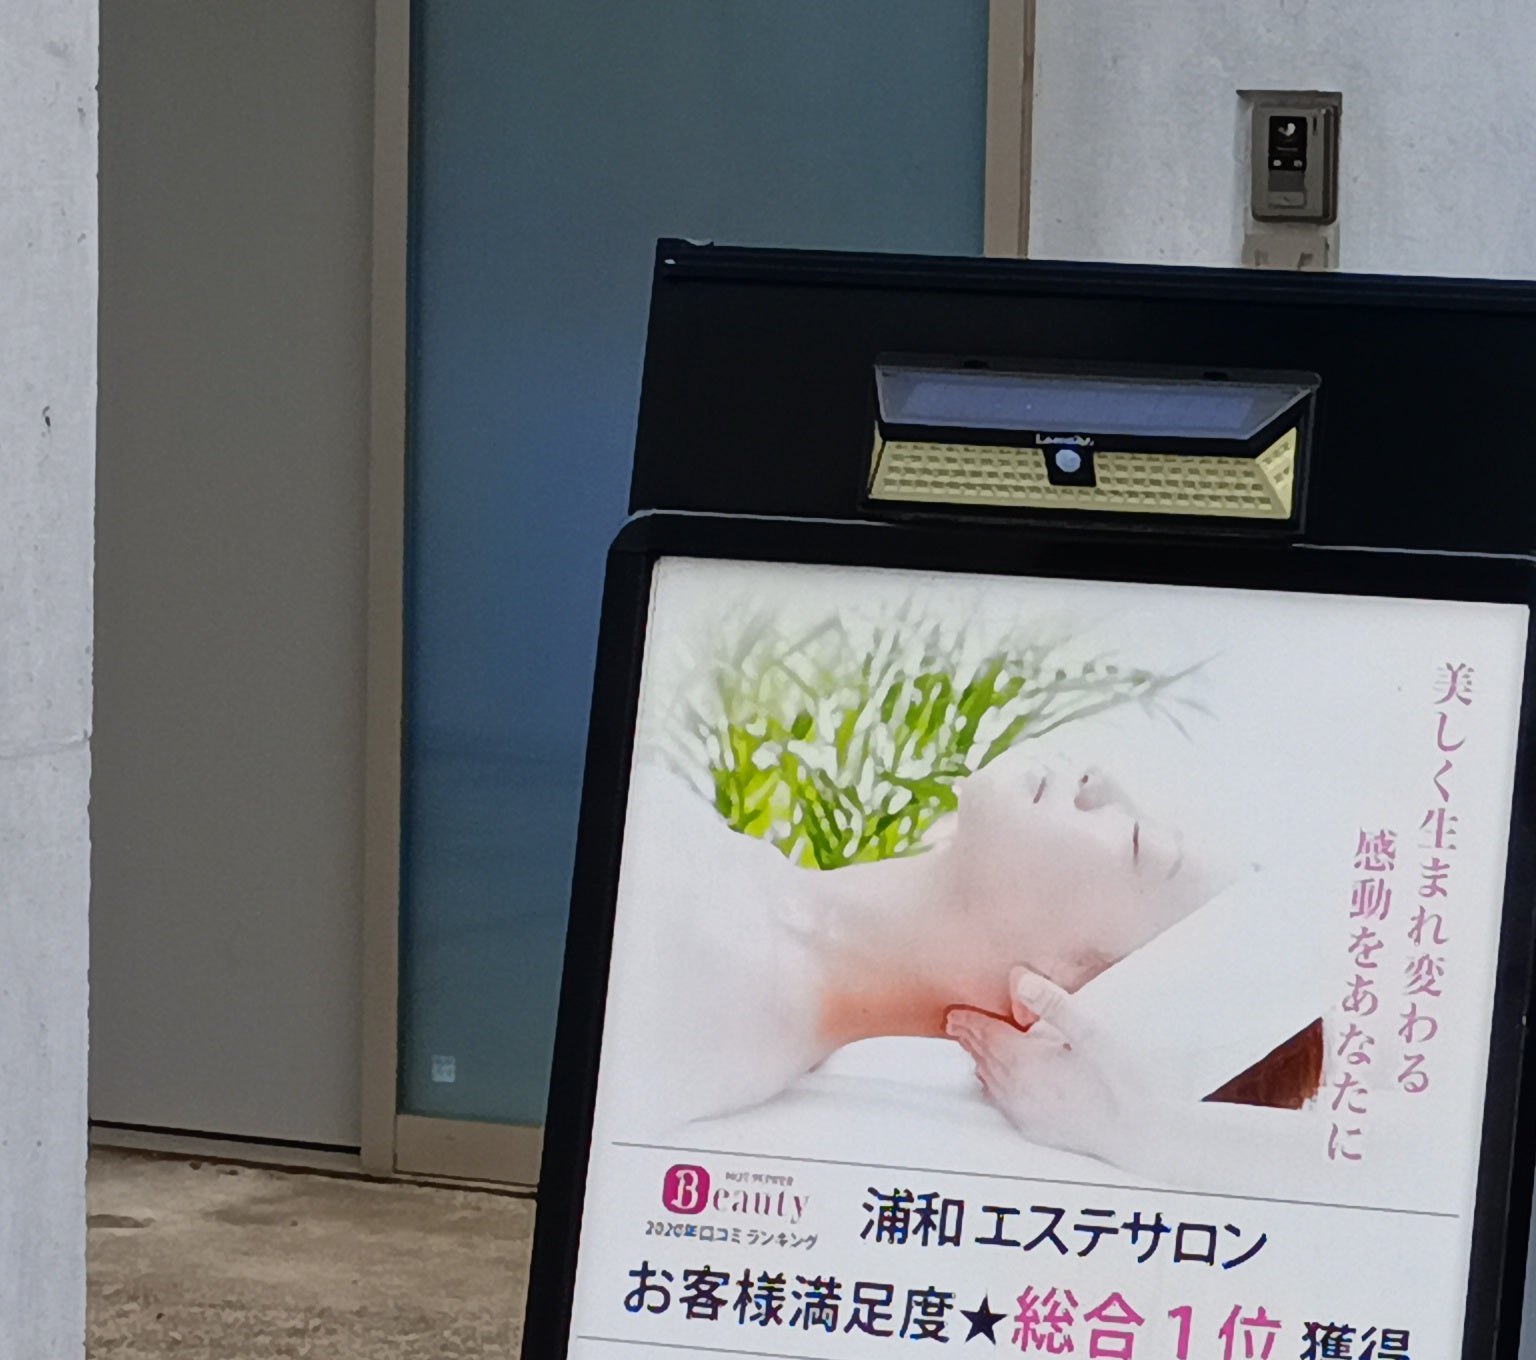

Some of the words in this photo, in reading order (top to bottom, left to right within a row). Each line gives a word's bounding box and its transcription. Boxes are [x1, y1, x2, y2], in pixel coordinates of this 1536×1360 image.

[1397, 661, 1475, 1094] 美しく生まれ変わる
[1327, 827, 1397, 1161] 感動をあなたに
[667, 1167, 810, 1225] Beauty
[859, 1186, 1268, 1270] 浦和エステサロン
